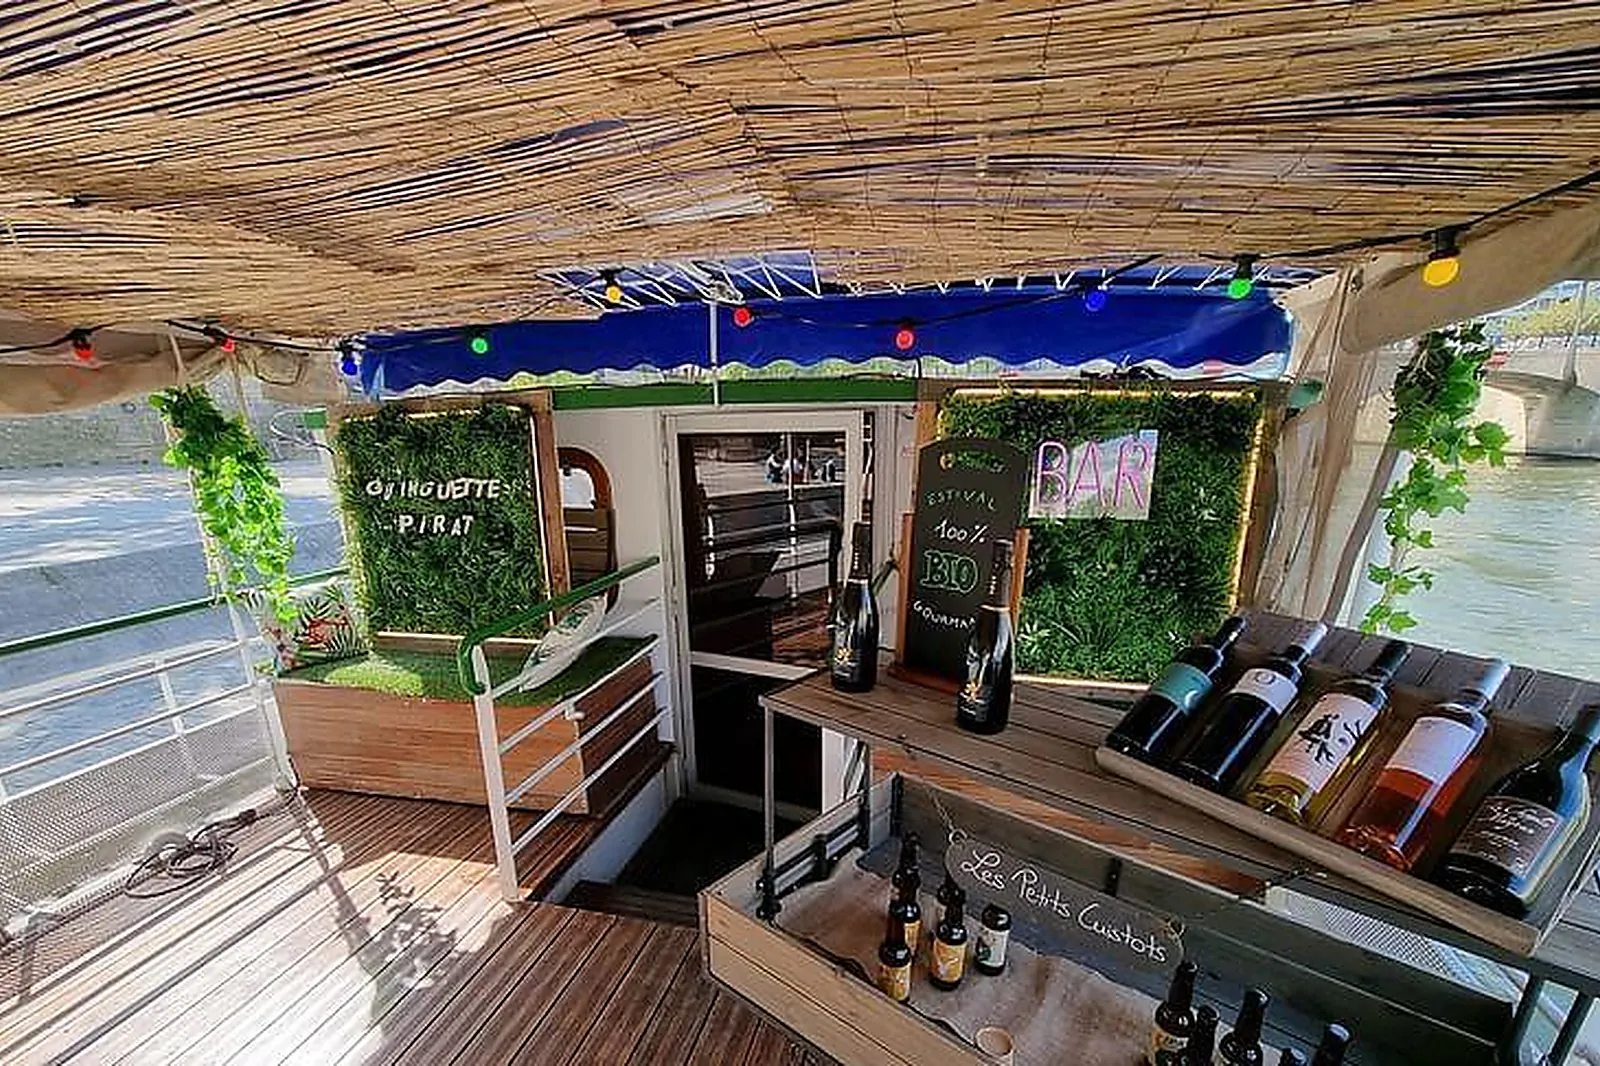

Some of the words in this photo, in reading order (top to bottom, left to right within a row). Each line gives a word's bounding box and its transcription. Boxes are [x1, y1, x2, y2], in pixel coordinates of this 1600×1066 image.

[1037, 436, 1150, 508] BAR
[398, 515, 474, 536] PIRAT
[934, 519, 988, 543] 100%
[920, 549, 978, 593] BIO
[960, 849, 1006, 890] Les
[1011, 868, 1071, 918] Petits
[1078, 902, 1166, 962] Cuistots
